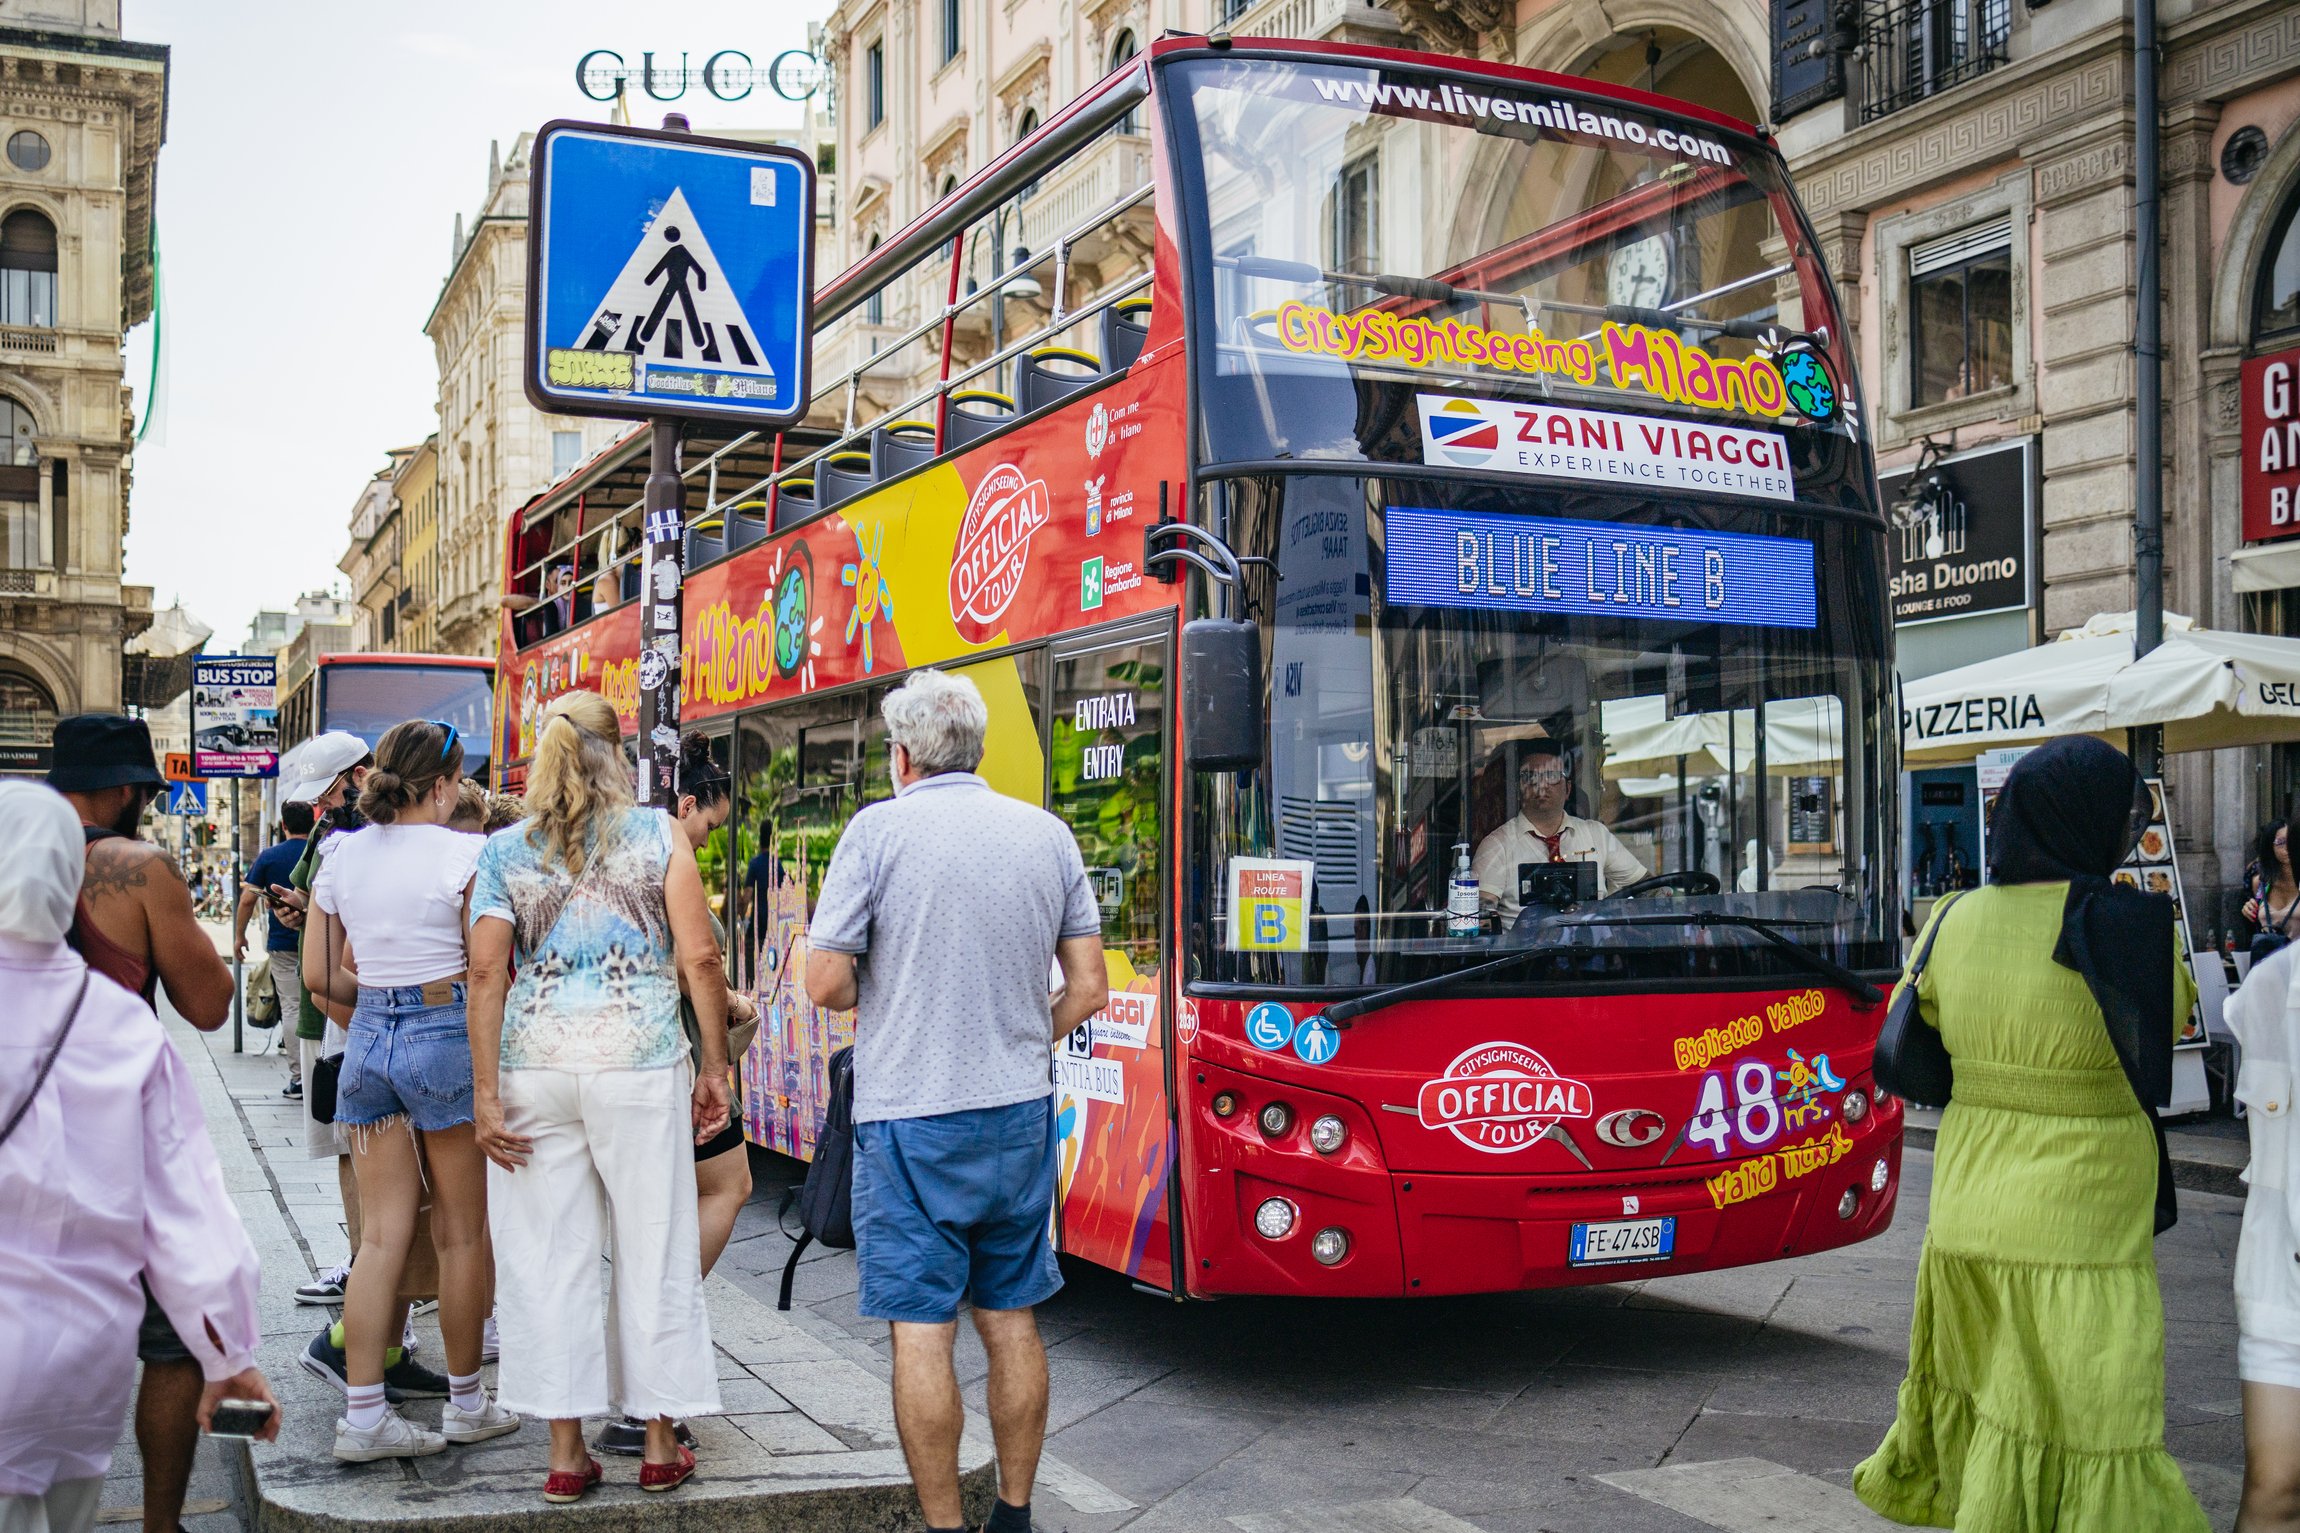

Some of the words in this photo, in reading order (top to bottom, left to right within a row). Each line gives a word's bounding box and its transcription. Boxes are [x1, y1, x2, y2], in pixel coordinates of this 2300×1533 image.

[1312, 78, 1732, 166] www.livemilano.com
[733, 378, 775, 398] Milano
[1601, 321, 1788, 418] Milano
[2263, 358, 2300, 420] G
[1513, 410, 1624, 452] ZANI
[1639, 424, 1784, 471] VIAGGI
[1518, 452, 1664, 481] EXPERIENCE
[1678, 467, 1788, 495] TOGETHER
[968, 475, 1019, 537] CITYSIGHTSEEING
[1110, 490, 1134, 507] rovincia
[1113, 505, 1133, 521] Milano
[958, 489, 1043, 602] OFFICIAL
[984, 554, 1022, 610] TOUR
[1104, 575, 1141, 596] Lombardia
[1105, 561, 1132, 580] Regione
[1456, 530, 1562, 598] BLUE
[1586, 540, 1682, 607] LINE
[1705, 548, 1726, 610] B
[1890, 569, 1928, 597] sha
[1934, 557, 2017, 590] Duomo
[1896, 599, 1934, 615] LOUNGE
[1935, 599, 1942, 609] &
[1944, 594, 1972, 608] FOOD
[695, 600, 774, 705] Milano
[198, 668, 230, 684] BUS
[232, 669, 274, 684] STOP
[1075, 692, 1135, 732] ENTRATA
[1904, 694, 2045, 740] PIZZERIA
[172, 759, 189, 774] TA
[300, 763, 315, 777] OSS
[1083, 744, 1125, 780] ENTRY
[1253, 886, 1287, 896] ROUTE
[1256, 873, 1285, 882] LINEA
[1254, 904, 1287, 944] B
[1178, 1012, 1195, 1031] 2031
[1674, 1015, 1764, 1072] Biglietto
[1767, 988, 1826, 1034] Valido
[1054, 1060, 1093, 1091] ENTIA
[1095, 1066, 1119, 1096] BUS
[1459, 1050, 1547, 1079] CITYSIGHTSEEING
[1437, 1080, 1583, 1119] OFFICIAL
[1688, 1062, 1779, 1154] 48
[1478, 1119, 1544, 1145] TOUR
[1706, 1154, 1777, 1210] Valid
